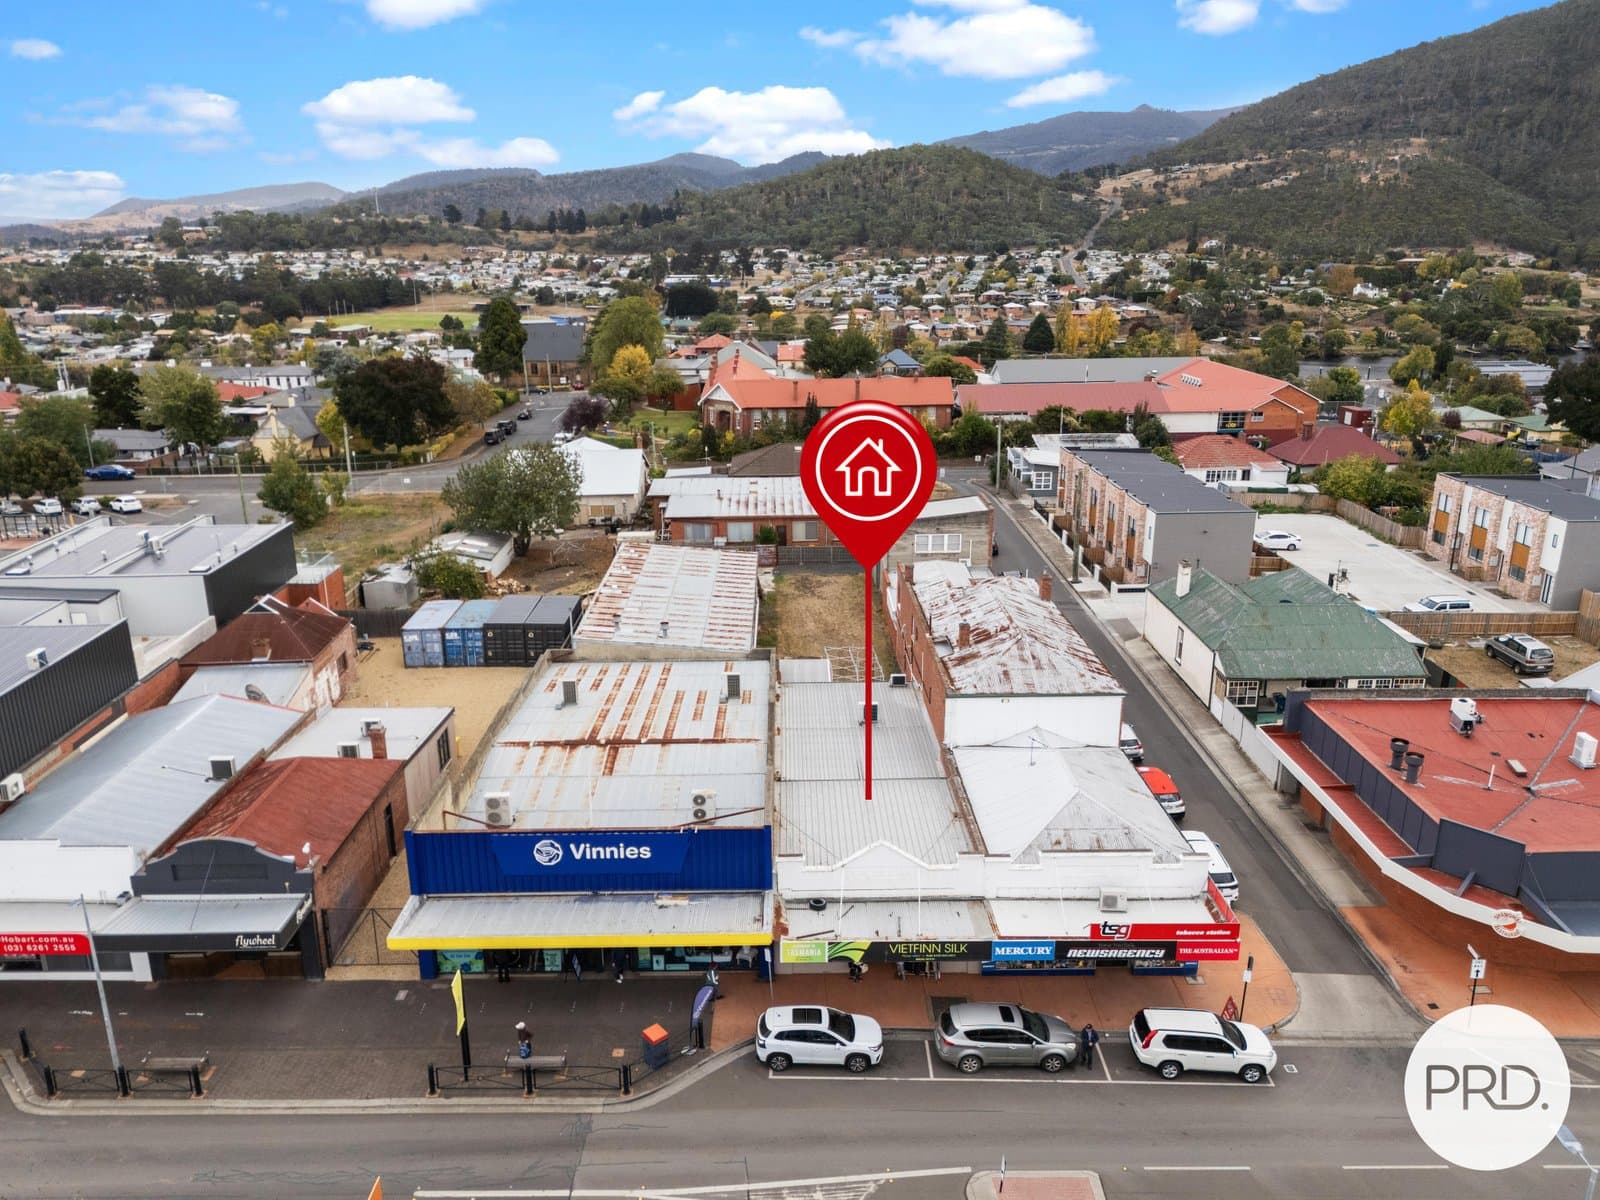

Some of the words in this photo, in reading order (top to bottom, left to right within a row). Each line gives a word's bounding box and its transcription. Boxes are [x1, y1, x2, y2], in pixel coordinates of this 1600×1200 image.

[569, 843, 652, 860] Vinnies
[1101, 920, 1131, 940] tsg
[0, 935, 75, 944] Hobart.com.au
[235, 934, 276, 947] flywheel
[3, 944, 24, 952] (03)
[26, 944, 49, 952] 6261
[52, 944, 77, 952] 2555
[889, 943, 942, 954] VIETFINN
[943, 943, 969, 954] SILK
[994, 946, 1053, 956] MERCURY
